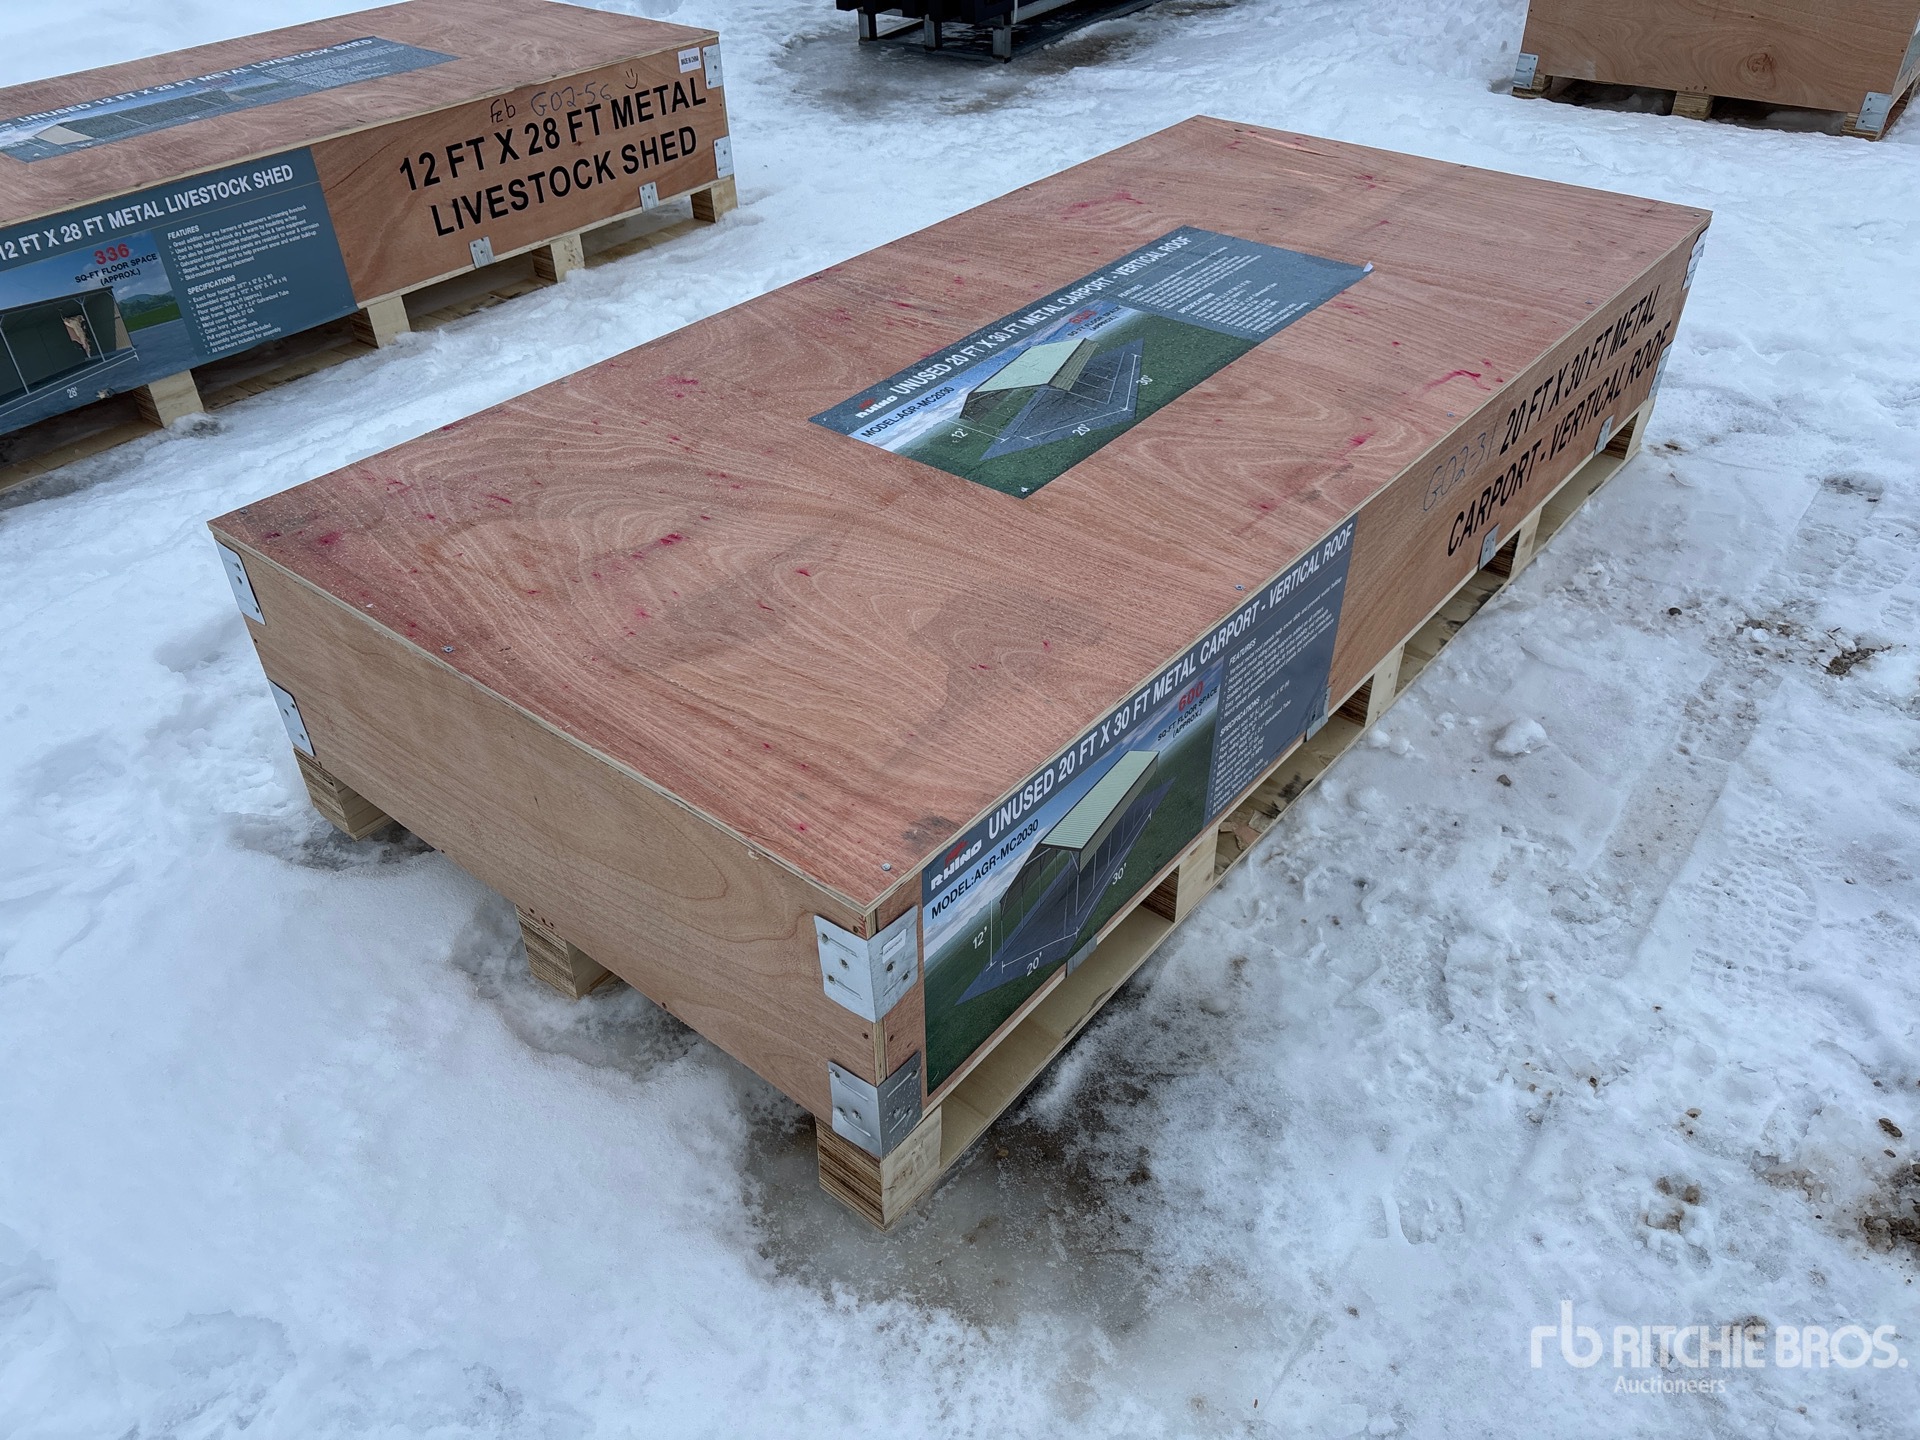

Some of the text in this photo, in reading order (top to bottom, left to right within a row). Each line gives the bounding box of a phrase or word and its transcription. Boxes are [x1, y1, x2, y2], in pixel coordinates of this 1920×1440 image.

[17, 103, 91, 122] UNUSED
[115, 91, 137, 101] FT
[175, 78, 197, 87] FT
[197, 67, 252, 82] METAL
[251, 48, 334, 69] LIVESTOCK
[333, 39, 373, 51] SHED
[399, 77, 706, 191] 12 FT X 28 FT METAL
[18, 233, 41, 254] FT
[43, 229, 60, 247] X
[60, 223, 82, 243] 28
[83, 215, 105, 236] FT
[107, 200, 165, 230] METAL
[167, 176, 253, 212] LIVESTOCK
[252, 163, 294, 189] SHED
[430, 125, 697, 237] LIVESTOCK SHED
[94, 243, 130, 265] 336
[166, 224, 200, 240] FEATURES
[74, 253, 158, 284] SQ-FT FLOOR SPACE
[100, 268, 141, 286] (APPROX.)
[186, 274, 236, 295] SPECIFICATIONS
[889, 362, 951, 396] UNUSED
[944, 354, 969, 370] 20
[960, 344, 985, 357] FT
[975, 339, 993, 349] X
[988, 331, 1012, 343] 30
[1002, 322, 1027, 335] FT
[1018, 304, 1067, 327] METAL
[1056, 276, 1115, 306] CARPORT
[1111, 250, 1168, 276] VERTICAL
[1162, 235, 1192, 254] ROOF
[1499, 284, 1661, 456] 20 FT X 30 FT METAL
[1447, 438, 1543, 557] CARPORT
[1549, 361, 1627, 461] VERTICAL
[1624, 320, 1671, 390] ROOF
[1229, 638, 1257, 666] FEATURES
[930, 839, 982, 891] RHINO
[988, 768, 1055, 840] UNUSED
[1057, 750, 1075, 783] 20
[1079, 731, 1098, 765] FT
[1100, 721, 1111, 749] X
[1113, 705, 1130, 736] 30
[1133, 687, 1151, 720] FT
[1152, 652, 1197, 705] METAL
[1200, 599, 1260, 665] CARPORT
[1269, 555, 1320, 609] VERTICAL
[1322, 522, 1353, 565] ROOF
[1158, 685, 1219, 741] SQ-FT FLOOR SPACE
[1178, 680, 1204, 712] 600
[1220, 695, 1260, 737] SPECIFICATIONS
[931, 819, 1039, 919] MODEL:AGR-MC2030
